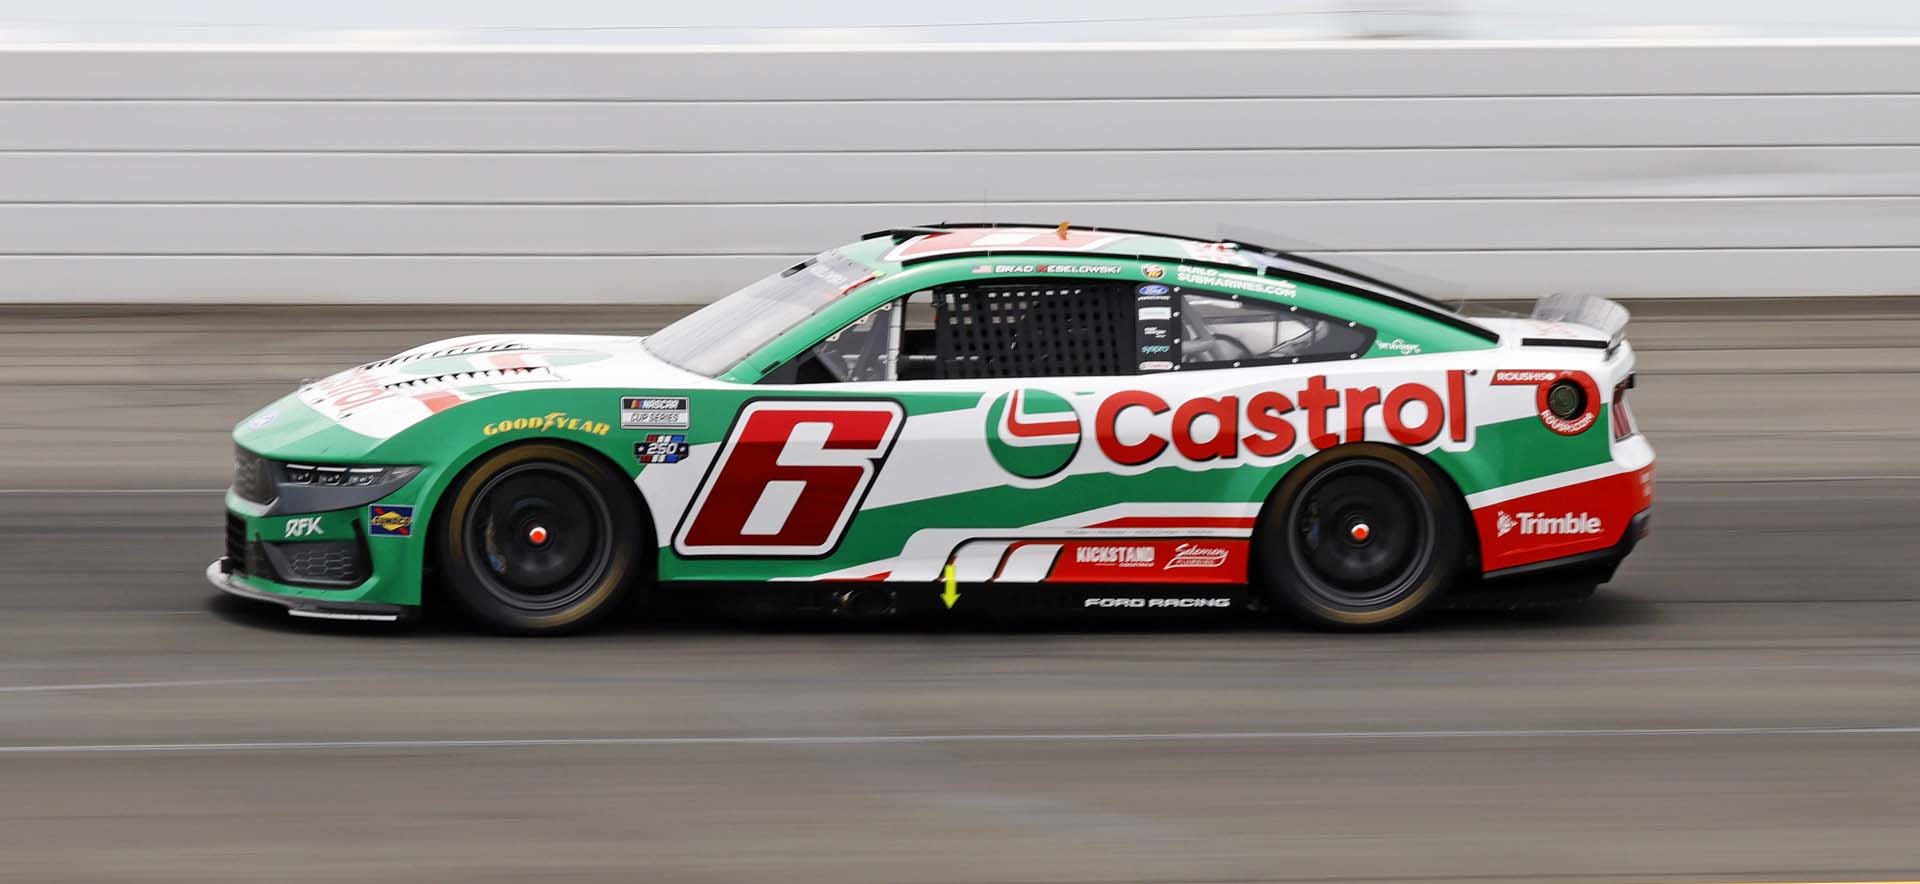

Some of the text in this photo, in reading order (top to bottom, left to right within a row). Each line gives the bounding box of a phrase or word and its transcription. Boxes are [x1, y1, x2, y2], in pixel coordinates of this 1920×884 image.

[995, 264, 1034, 273] BRAD
[1177, 273, 1298, 299] SUBMARINES.COM
[642, 398, 680, 410] NASCAR
[483, 412, 611, 436] GOODYEAR
[631, 411, 680, 423] CUP SERIES
[1095, 368, 1467, 466] Castrol
[647, 442, 680, 455] 250
[678, 403, 900, 553] 6
[1515, 512, 1602, 535] Trimble
[1076, 547, 1155, 563] KICKSTAND
[1084, 598, 1231, 608] FORD RACING
